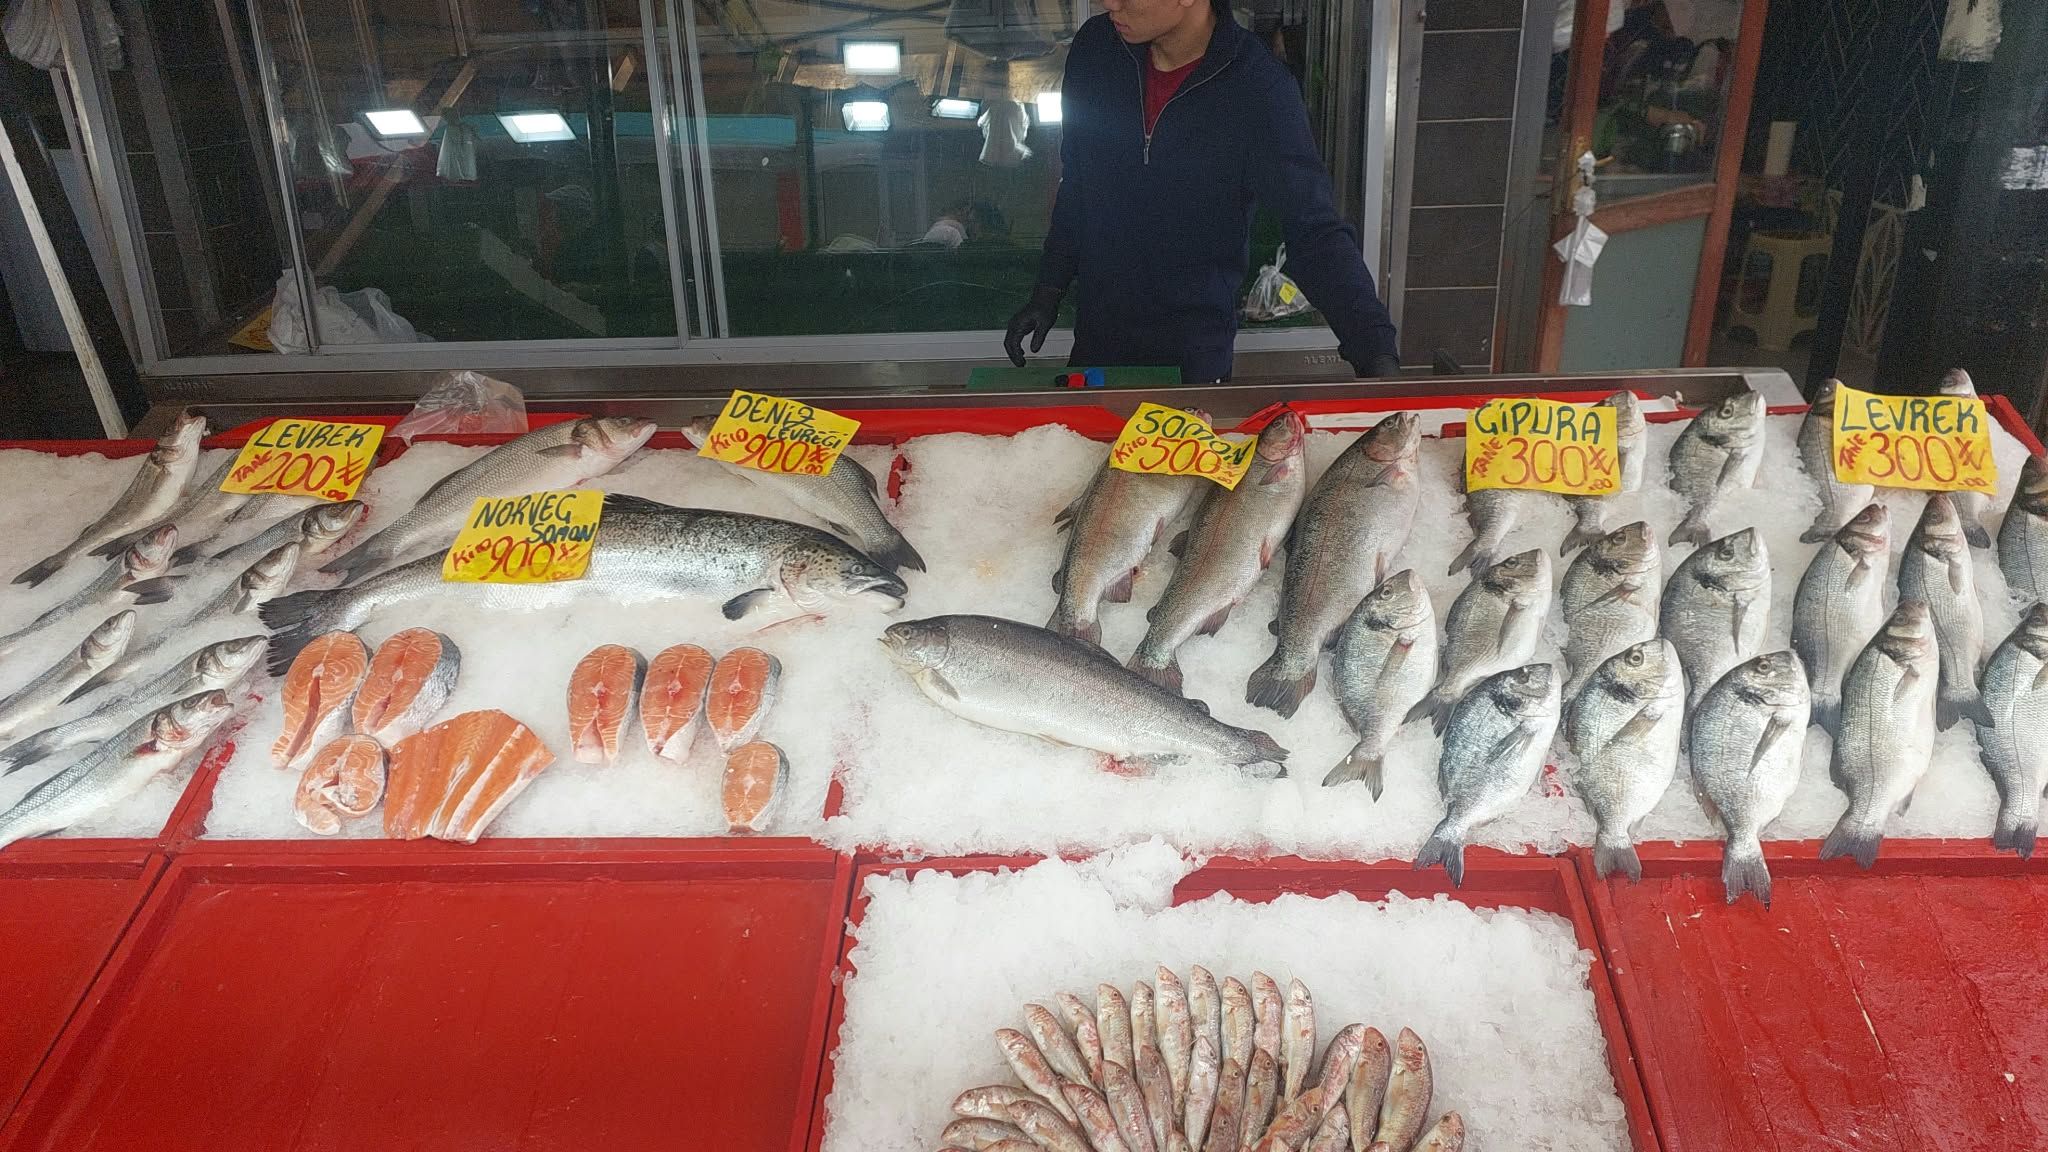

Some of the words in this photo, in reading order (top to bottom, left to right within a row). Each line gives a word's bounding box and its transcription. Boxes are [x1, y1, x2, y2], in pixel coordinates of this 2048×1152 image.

[1840, 393, 1978, 434] LEVREK
[254, 423, 372, 449] LEVREK
[736, 434, 810, 472] 900
[1136, 409, 1253, 465] SOMON
[1138, 436, 1222, 474] 500
[250, 451, 336, 492] 200
[1501, 437, 1588, 488] 300
[1868, 432, 1957, 482] 300
[473, 492, 577, 529] NORVEG
[479, 535, 555, 580] 900
